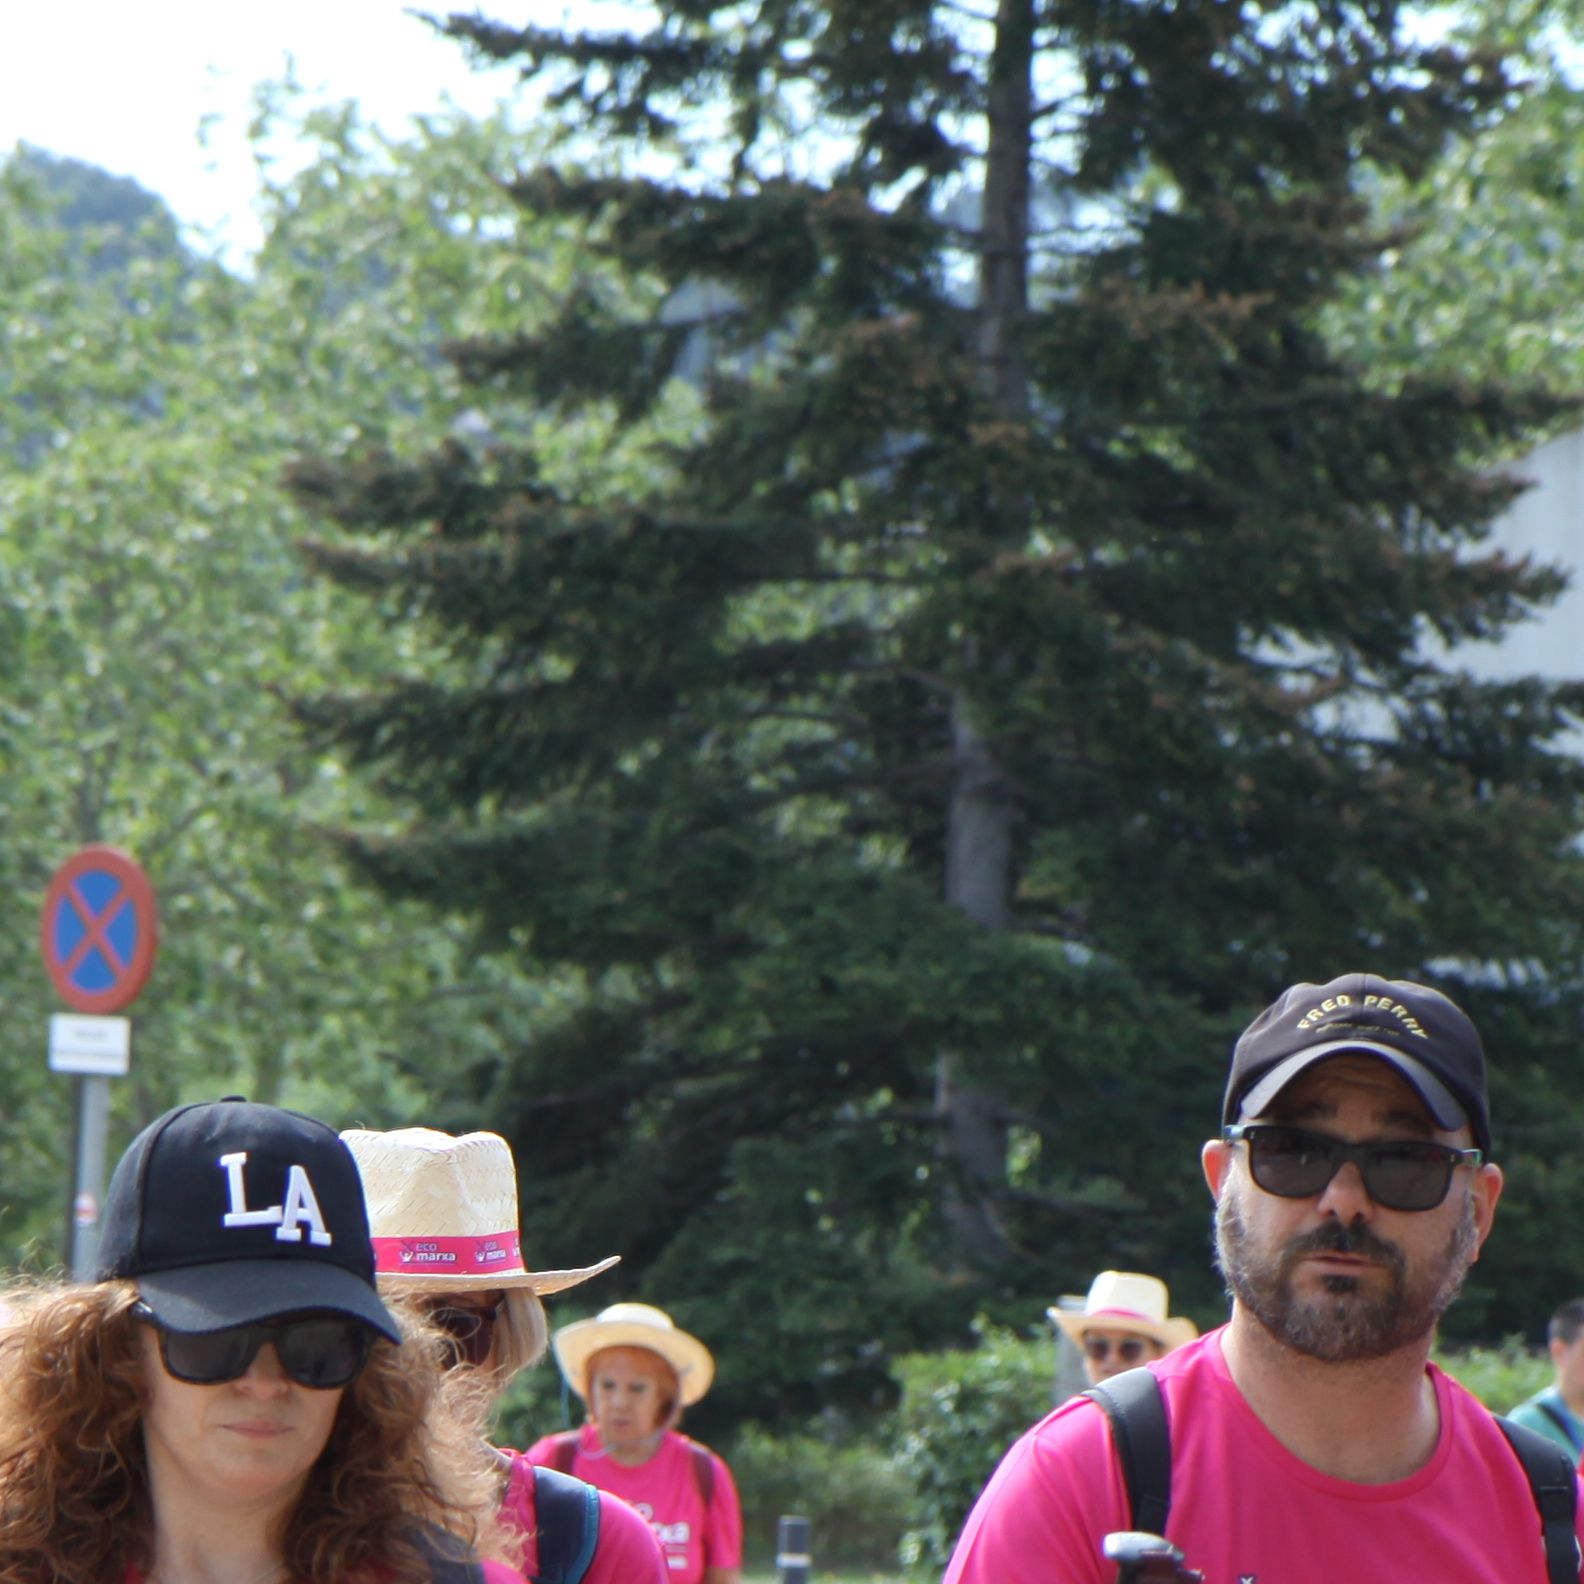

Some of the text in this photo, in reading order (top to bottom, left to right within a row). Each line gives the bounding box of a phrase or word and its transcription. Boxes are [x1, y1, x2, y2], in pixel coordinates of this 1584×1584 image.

[1297, 994, 1351, 1029] FRED
[1364, 995, 1428, 1039] PERRY
[220, 1152, 332, 1246] LA
